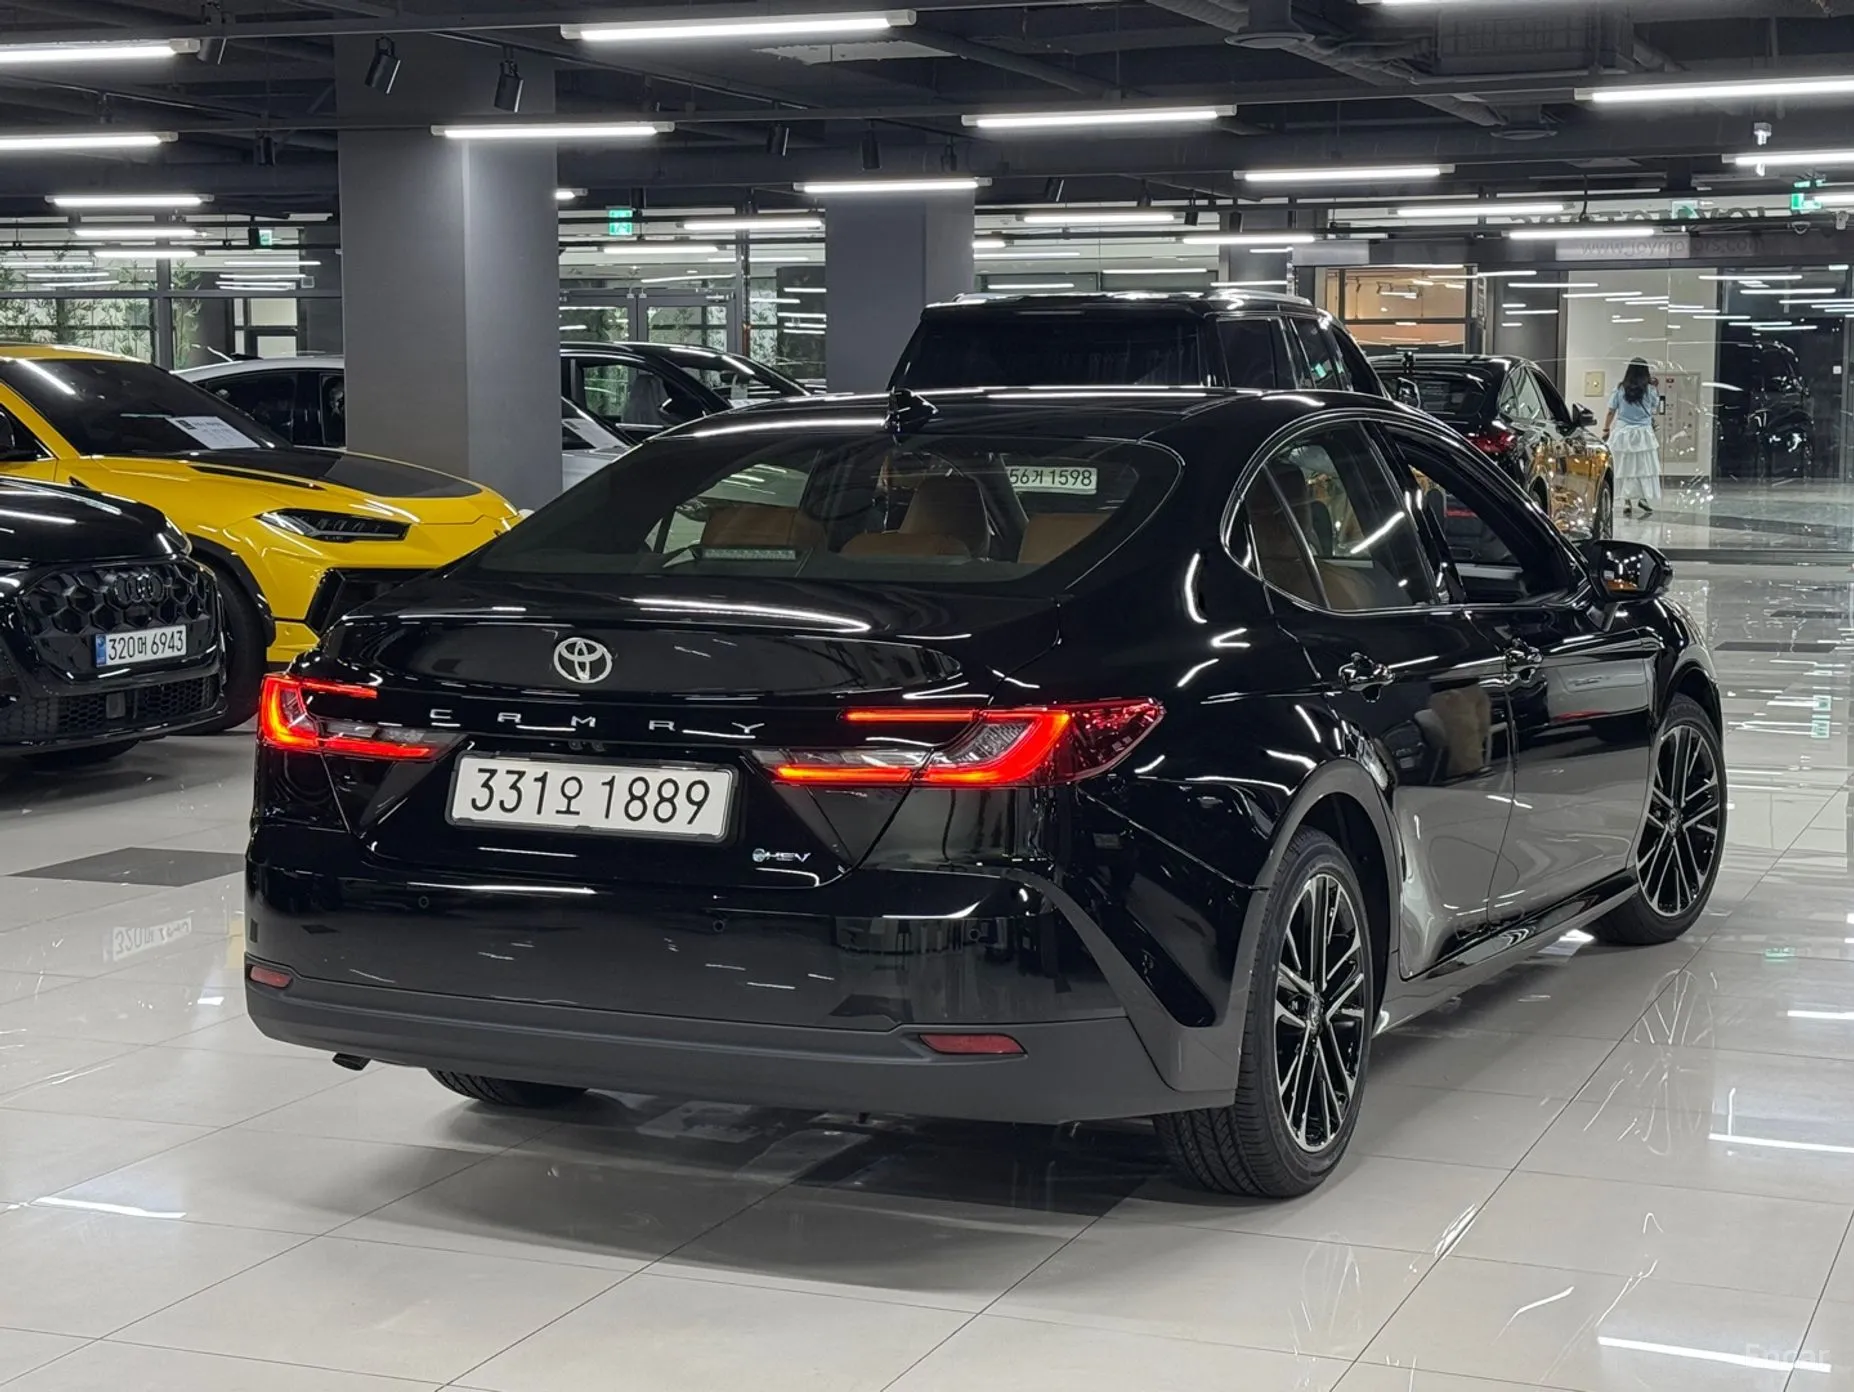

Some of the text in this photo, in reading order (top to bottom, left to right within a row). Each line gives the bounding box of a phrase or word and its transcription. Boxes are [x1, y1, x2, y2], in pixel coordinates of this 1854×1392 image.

[1580, 236, 1765, 257] www.joymoors.com
[1048, 468, 1092, 486] 1598
[150, 629, 183, 656] 6943
[429, 708, 766, 734] CAMRY
[471, 767, 711, 826] 331오 1889
